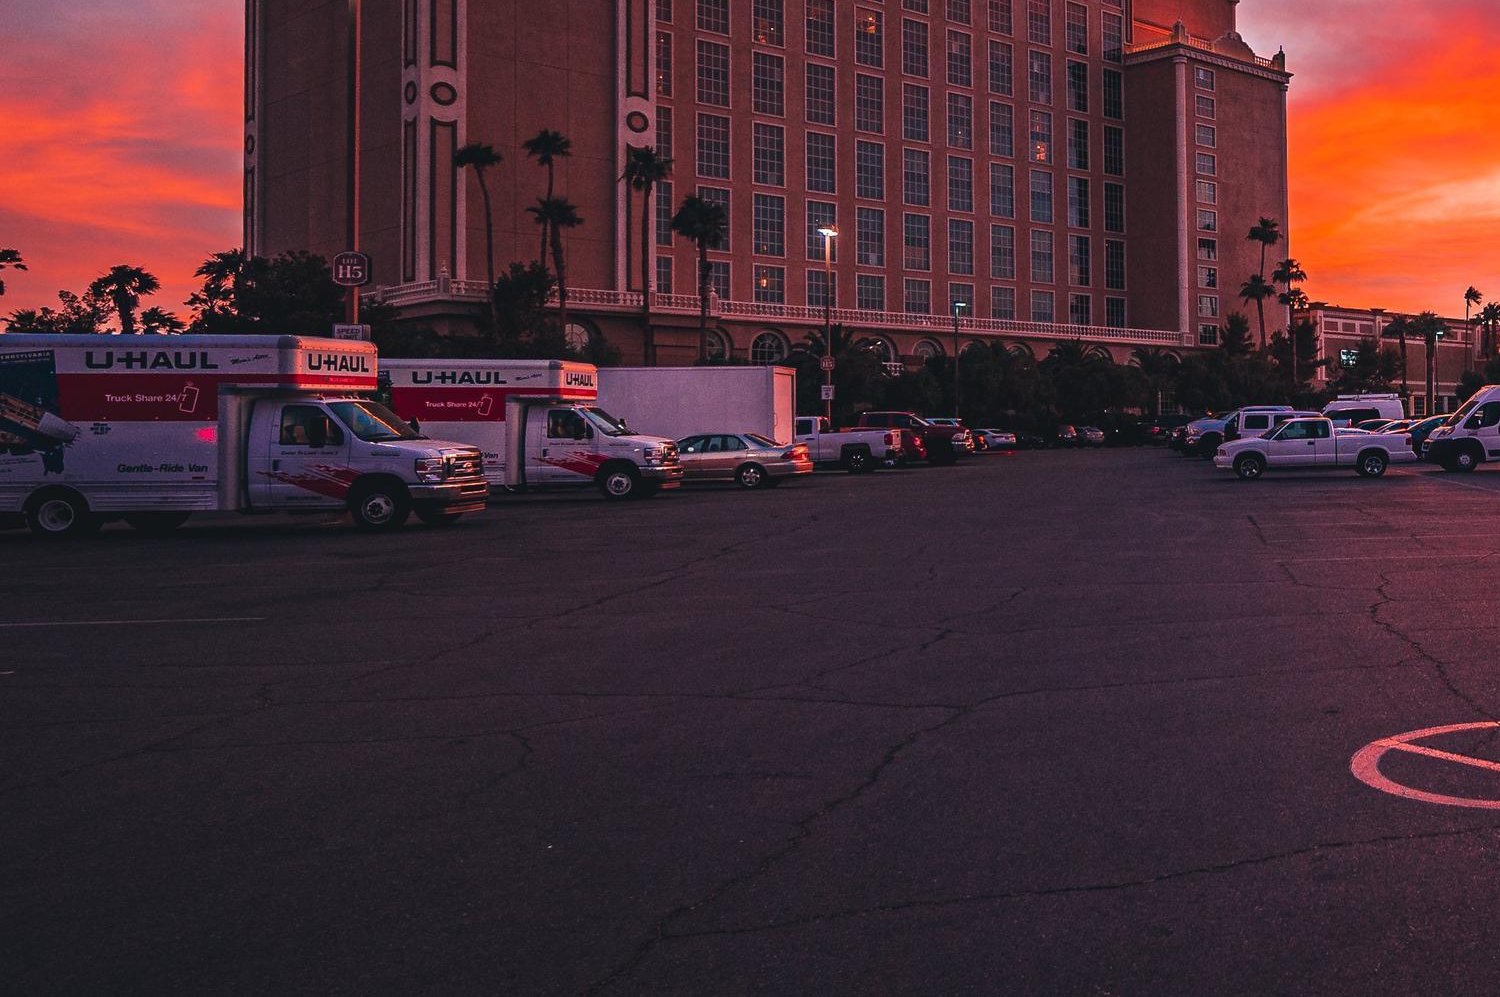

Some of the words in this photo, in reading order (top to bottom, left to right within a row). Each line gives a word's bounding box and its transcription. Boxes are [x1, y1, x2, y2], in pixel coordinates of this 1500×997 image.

[342, 257, 357, 265] LOT
[338, 265, 362, 279] H5
[85, 351, 219, 370] U-HAUL
[308, 352, 370, 373] U-HAUL
[412, 370, 508, 385] U-HAUL
[565, 372, 595, 387] U-HAUL
[104, 394, 133, 402] Truck
[135, 394, 163, 402] Share
[165, 393, 187, 403] 24/7
[117, 463, 185, 473] Gentle-Ride
[188, 463, 209, 473] Van
